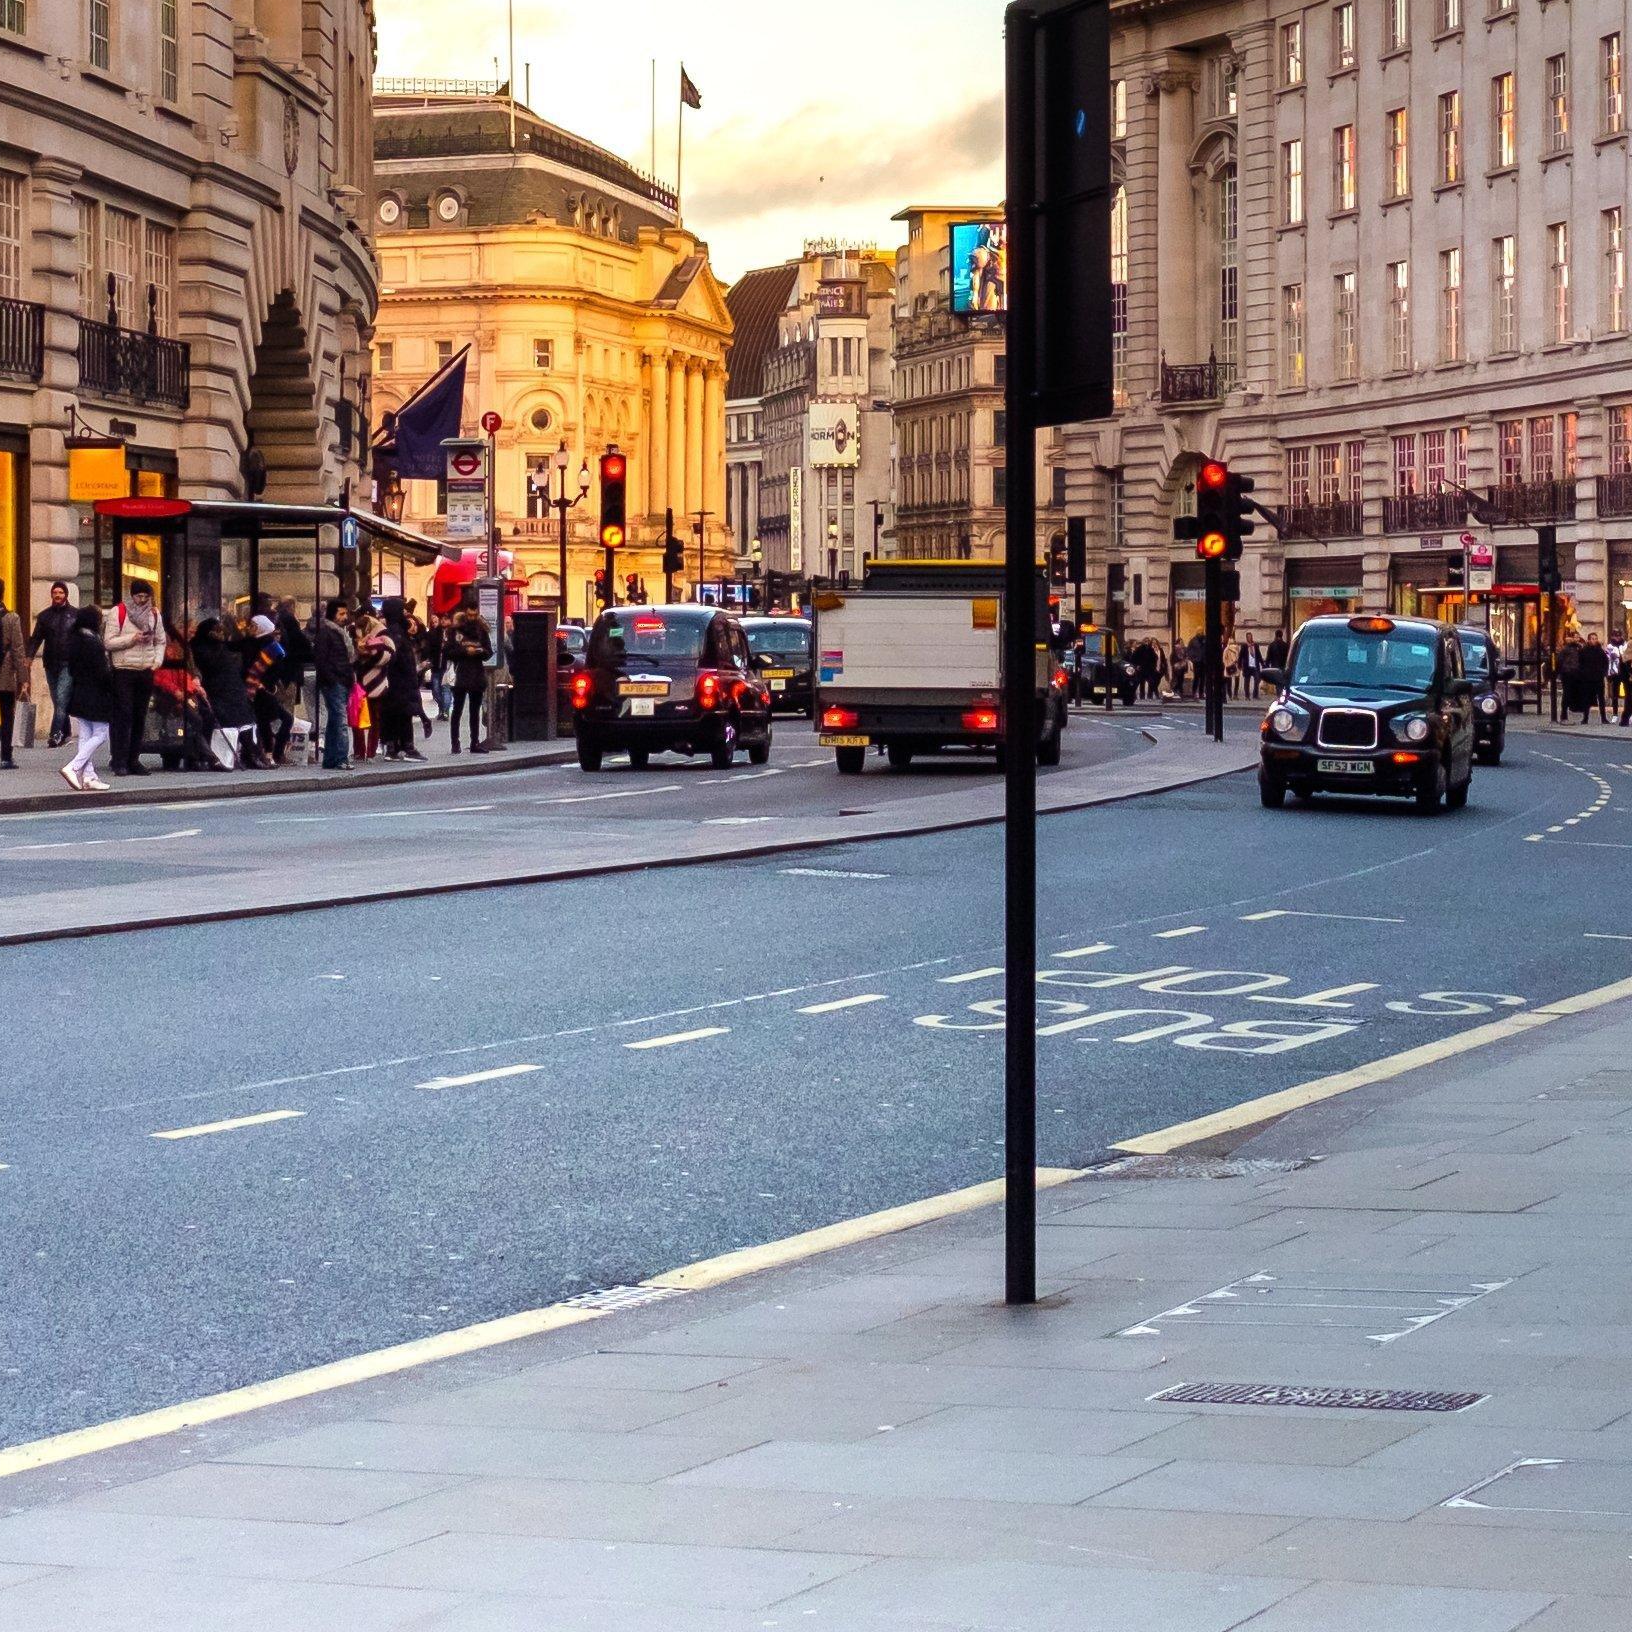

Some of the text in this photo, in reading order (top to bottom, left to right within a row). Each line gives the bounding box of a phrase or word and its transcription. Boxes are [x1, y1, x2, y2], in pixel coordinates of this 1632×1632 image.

[486, 414, 497, 430] F
[1035, 966, 1529, 1016] STOP
[913, 999, 1360, 1055] BUS
